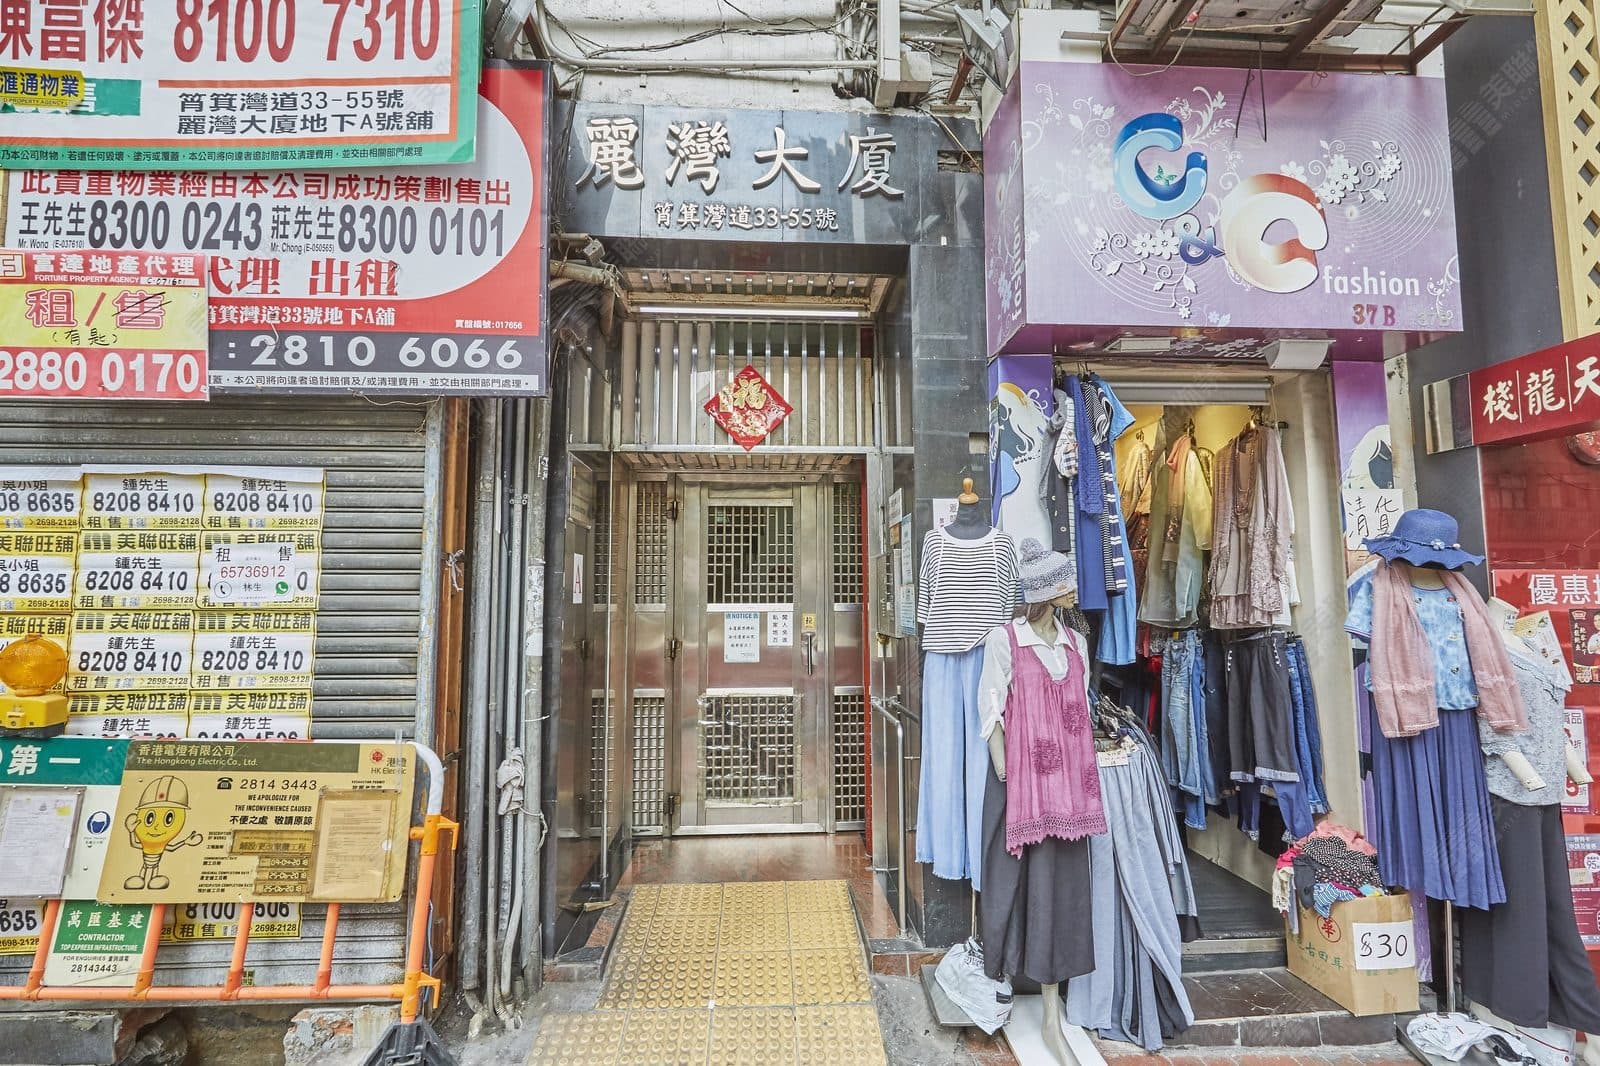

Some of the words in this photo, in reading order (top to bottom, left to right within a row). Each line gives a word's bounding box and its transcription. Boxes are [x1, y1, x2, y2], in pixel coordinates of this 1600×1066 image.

[174, 0, 295, 62] 8100
[323, 0, 440, 61] 7310
[179, 89, 404, 112] 筲箕灣道33-55號
[575, 117, 904, 199] 麗灣大廈
[654, 202, 840, 231] 筲箕灣道33-55號
[19, 201, 86, 236] 王先生
[88, 200, 170, 249] 8300
[182, 201, 262, 251] 0243
[270, 205, 335, 240] 莊先生
[338, 204, 417, 254] 8300
[429, 207, 504, 257] 0101
[33, 253, 195, 275] 富達地產代理
[70, 275, 108, 283] PROPERTY
[110, 276, 139, 284] AGENCY
[309, 257, 399, 296] 出租
[1322, 265, 1420, 296] fashion
[250, 335, 376, 367] 2810
[399, 337, 523, 369] 6066
[102, 352, 199, 393] 0170
[27, 493, 75, 512] 8635
[93, 492, 140, 512] 8208
[147, 492, 194, 512] 8410
[214, 492, 260, 512] 8208
[266, 493, 313, 512] 8410
[85, 571, 134, 590] 8208
[140, 571, 188, 590] 8410
[221, 565, 286, 578] 65736912
[18, 574, 66, 593] 8635
[78, 651, 127, 671] 8208
[134, 651, 182, 672] 8410
[202, 651, 249, 670] 8208
[256, 651, 303, 670] 8410
[137, 757, 152, 765] The
[154, 757, 195, 767] Hongkong
[197, 758, 226, 766] Electric
[240, 779, 275, 790] 2814
[281, 779, 317, 791] 3443
[78, 933, 125, 942] CONTRACTOR
[94, 944, 138, 952] INFRASTRUCTURE
[71, 963, 118, 973] 28143443
